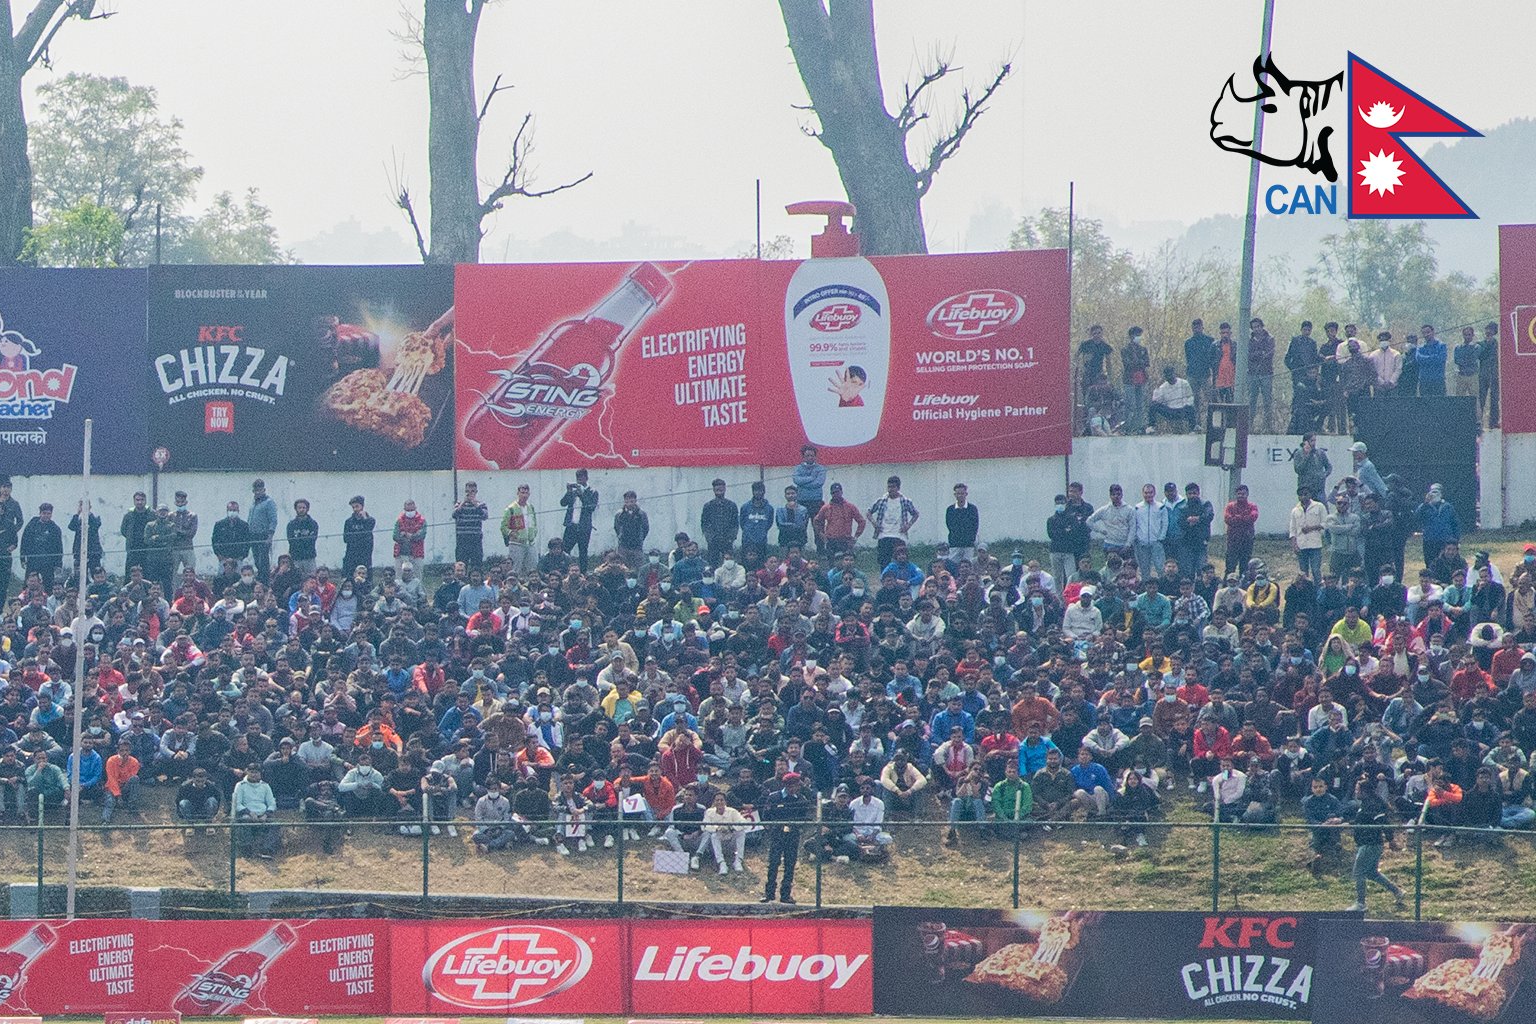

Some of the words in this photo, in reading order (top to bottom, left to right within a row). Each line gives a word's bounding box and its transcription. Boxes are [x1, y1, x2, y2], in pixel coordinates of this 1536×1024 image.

[174, 288, 237, 299] BLOCKBUSTER
[815, 313, 859, 322] Lifebuoy
[938, 305, 1015, 322] Lifebuoy
[197, 326, 245, 342] KFC
[642, 323, 746, 359] ELECTRIFYING
[809, 343, 839, 352] 99.9%
[916, 349, 991, 364] WORLD'S
[996, 347, 1023, 361] NO.
[1027, 347, 1034, 359] 1
[154, 345, 290, 396] CHIZZA
[688, 350, 746, 379] ENERGY
[916, 365, 946, 373] SELLING
[968, 362, 1013, 371] PROTECTION
[168, 394, 186, 405] ALL
[230, 388, 244, 397] NO
[245, 389, 276, 405] CRUST.
[505, 383, 599, 406] STING
[674, 375, 747, 406] ULTIMATE
[913, 393, 980, 406] Lifebuoy
[212, 406, 228, 418] TRY
[524, 405, 592, 420] ENERGY
[701, 401, 748, 428] TASTE
[912, 408, 953, 421] Official
[956, 407, 1002, 421] Hygiene
[1005, 405, 1048, 417] Partner
[211, 417, 229, 429] NOW
[1198, 916, 1298, 949] KFC
[69, 933, 134, 955] ELECTRIFYING
[309, 933, 374, 955] ELECTRIFYING
[98, 951, 133, 967] ENERGY
[338, 951, 374, 967] ENERGY
[442, 954, 573, 979] Lifebuoy
[634, 945, 869, 989] Lifebuoy
[89, 964, 134, 983] ULTIMATE
[329, 964, 374, 983] ULTIMATE
[1181, 954, 1314, 1004] CHIZZA
[107, 979, 135, 996] TASTE
[198, 982, 251, 999] STING
[346, 979, 375, 996] TASTE
[1204, 997, 1216, 1008] ALL
[1243, 993, 1259, 1001] NO
[1260, 993, 1298, 1010] CRUST.
